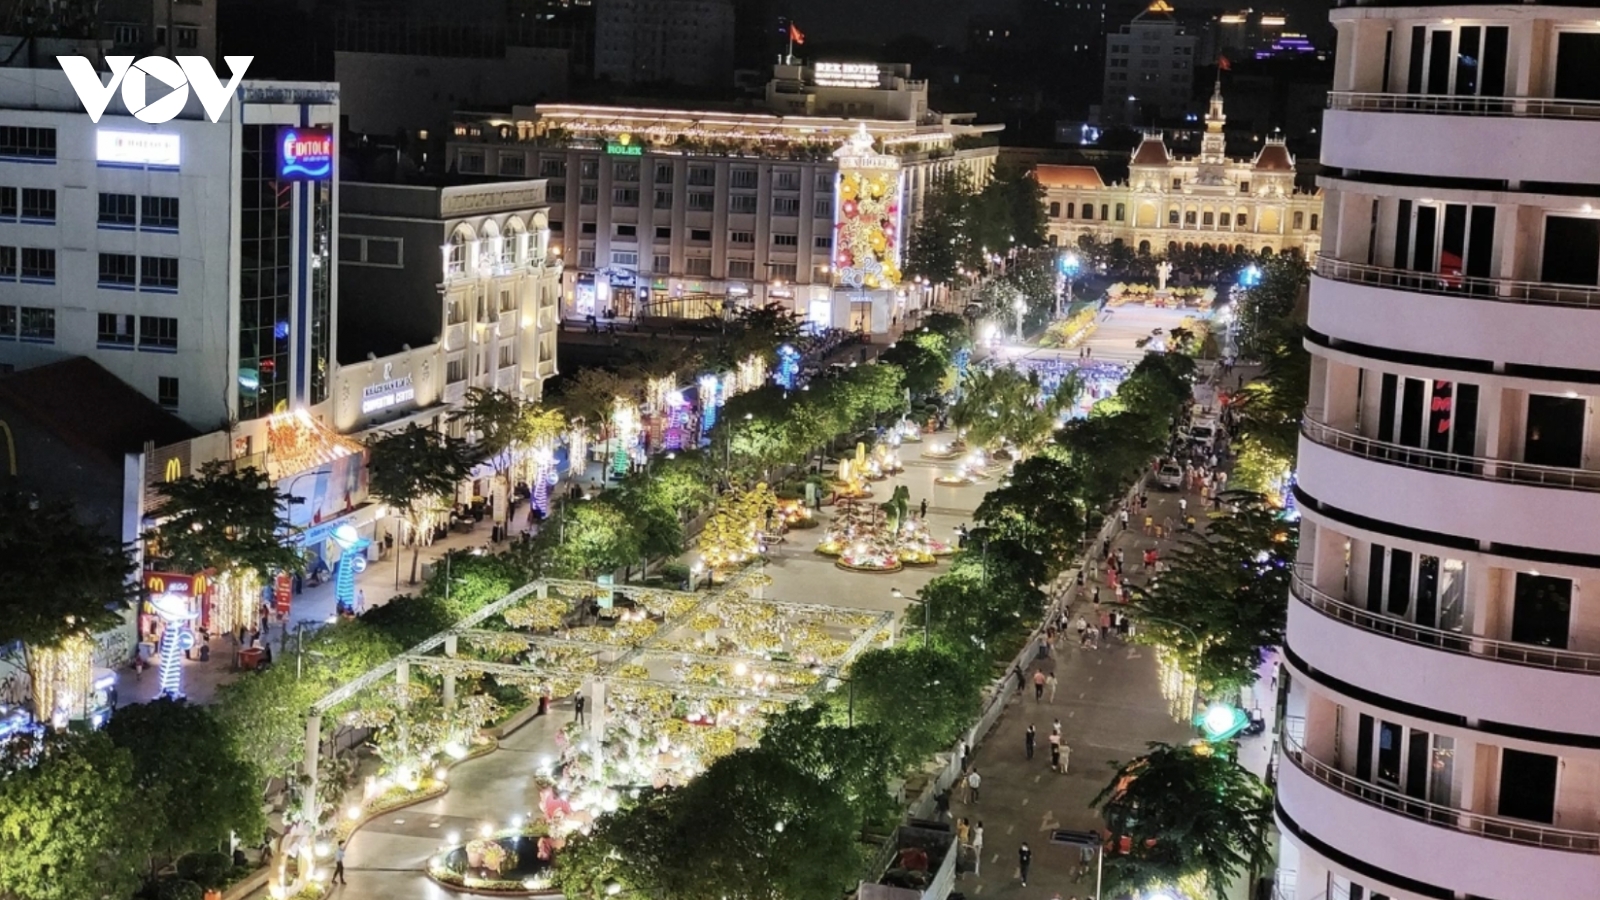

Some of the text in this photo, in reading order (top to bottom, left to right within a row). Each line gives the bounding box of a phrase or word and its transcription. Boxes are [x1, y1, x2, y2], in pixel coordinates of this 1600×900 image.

[816, 63, 880, 74] REX HOTEL
[607, 145, 643, 156] ROLEX
